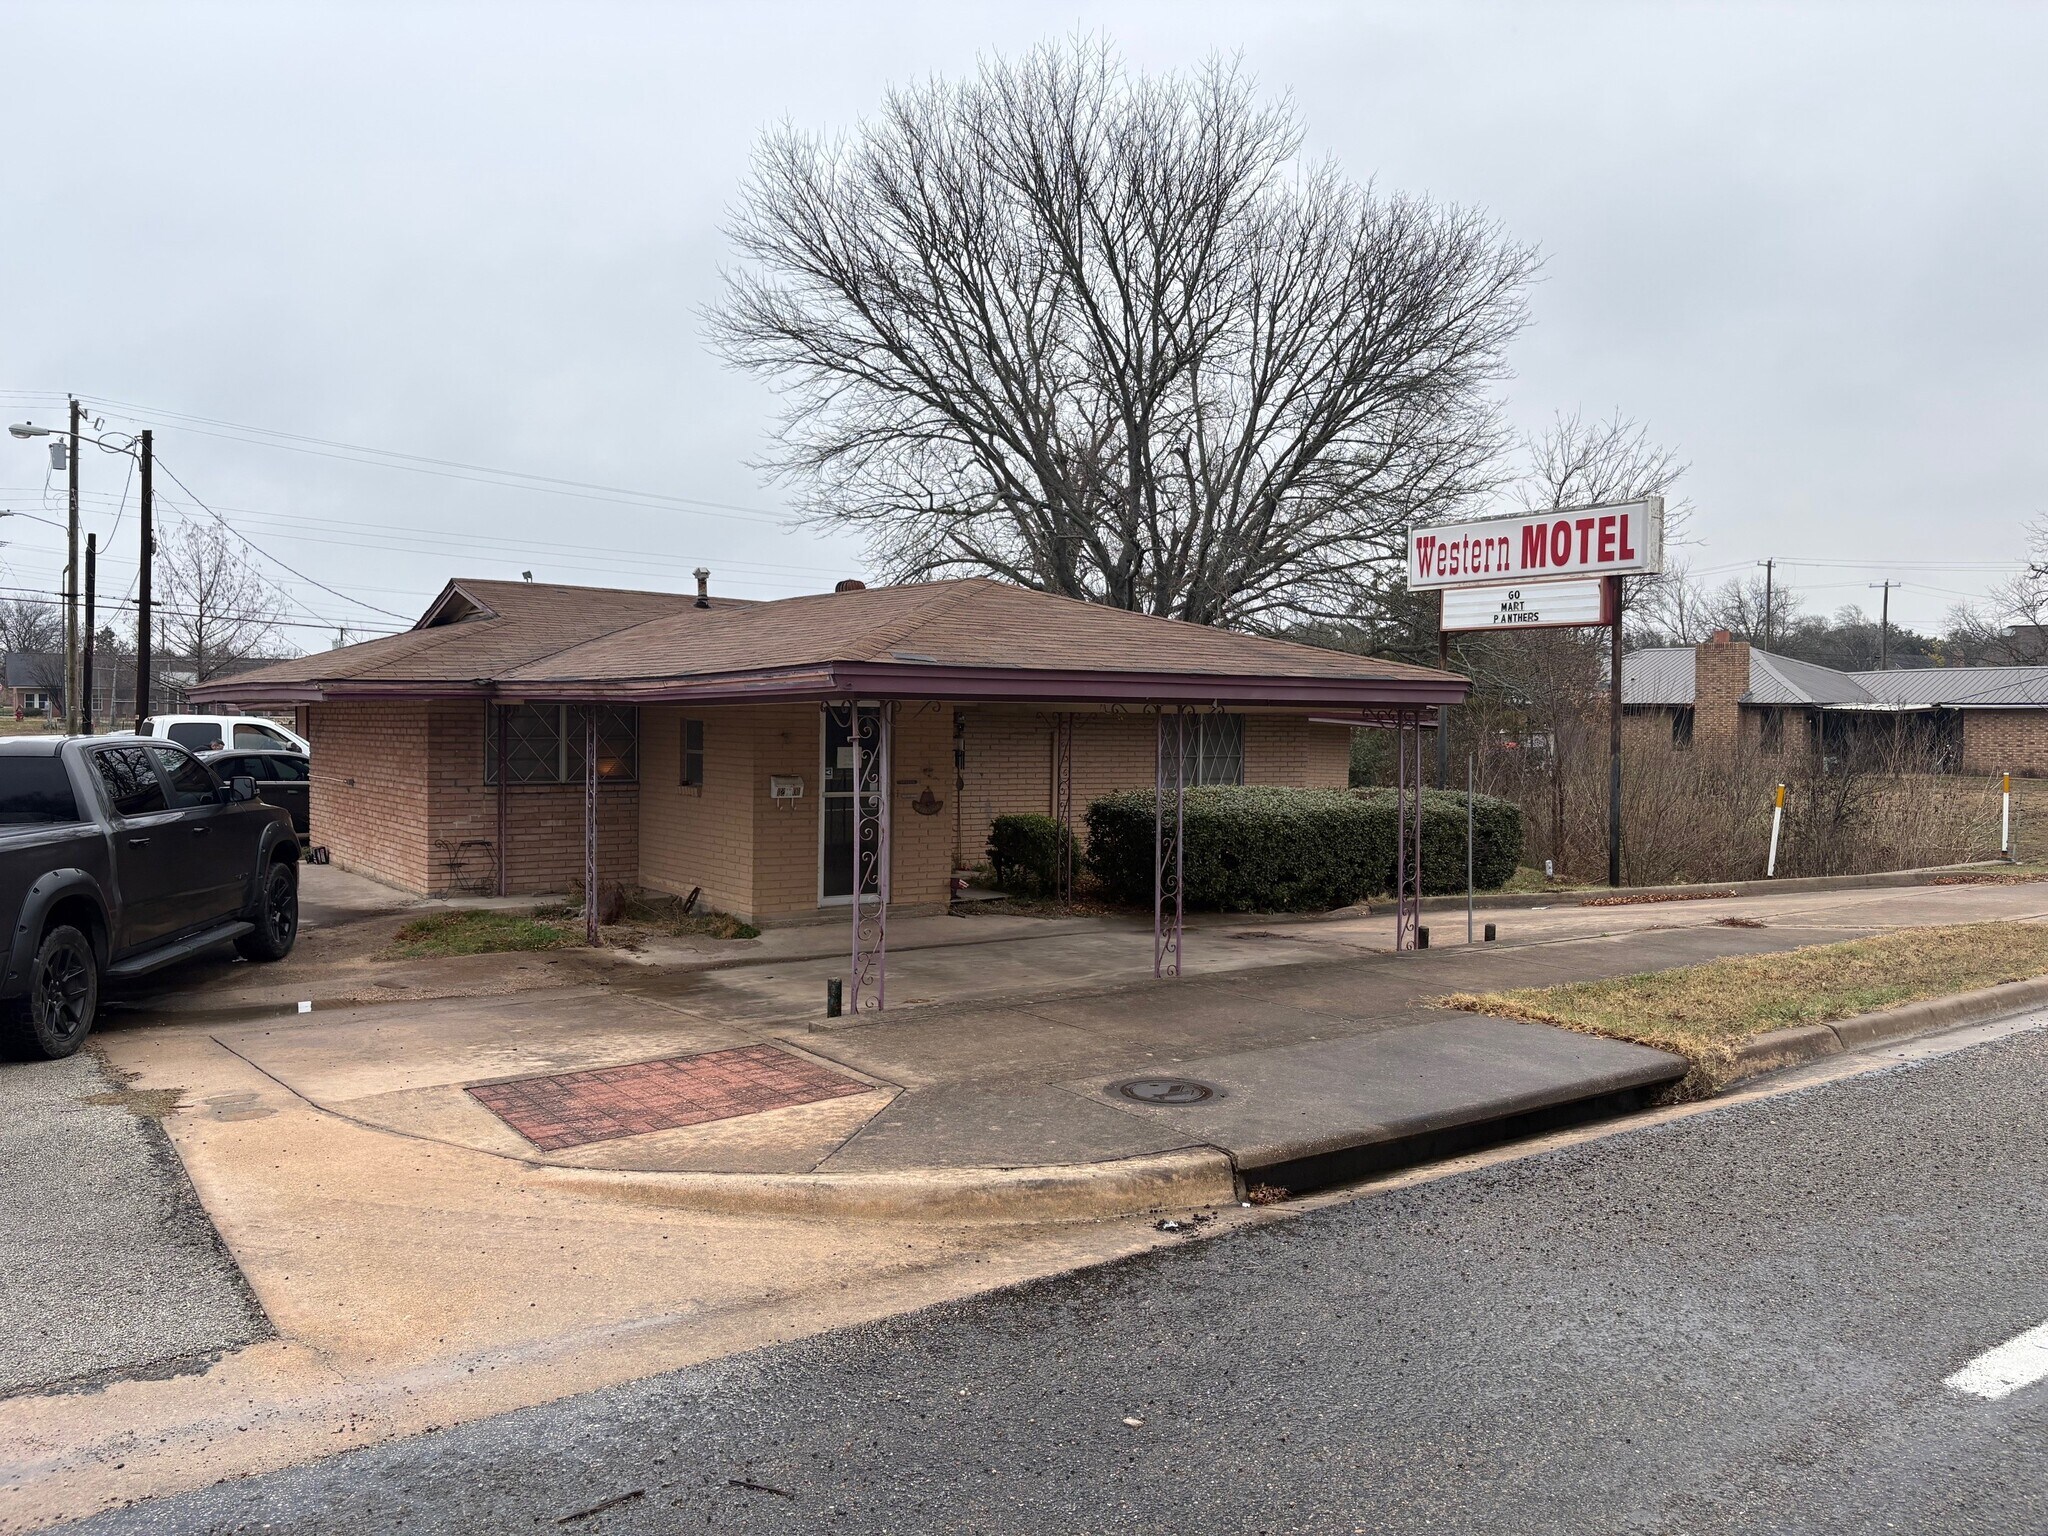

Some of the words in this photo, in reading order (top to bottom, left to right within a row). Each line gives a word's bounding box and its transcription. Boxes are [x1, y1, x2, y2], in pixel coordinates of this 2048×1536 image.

[1416, 533, 1510, 578] Western
[1521, 514, 1635, 570] MOTEL
[1508, 590, 1520, 600] GO
[1500, 601, 1525, 612] MART
